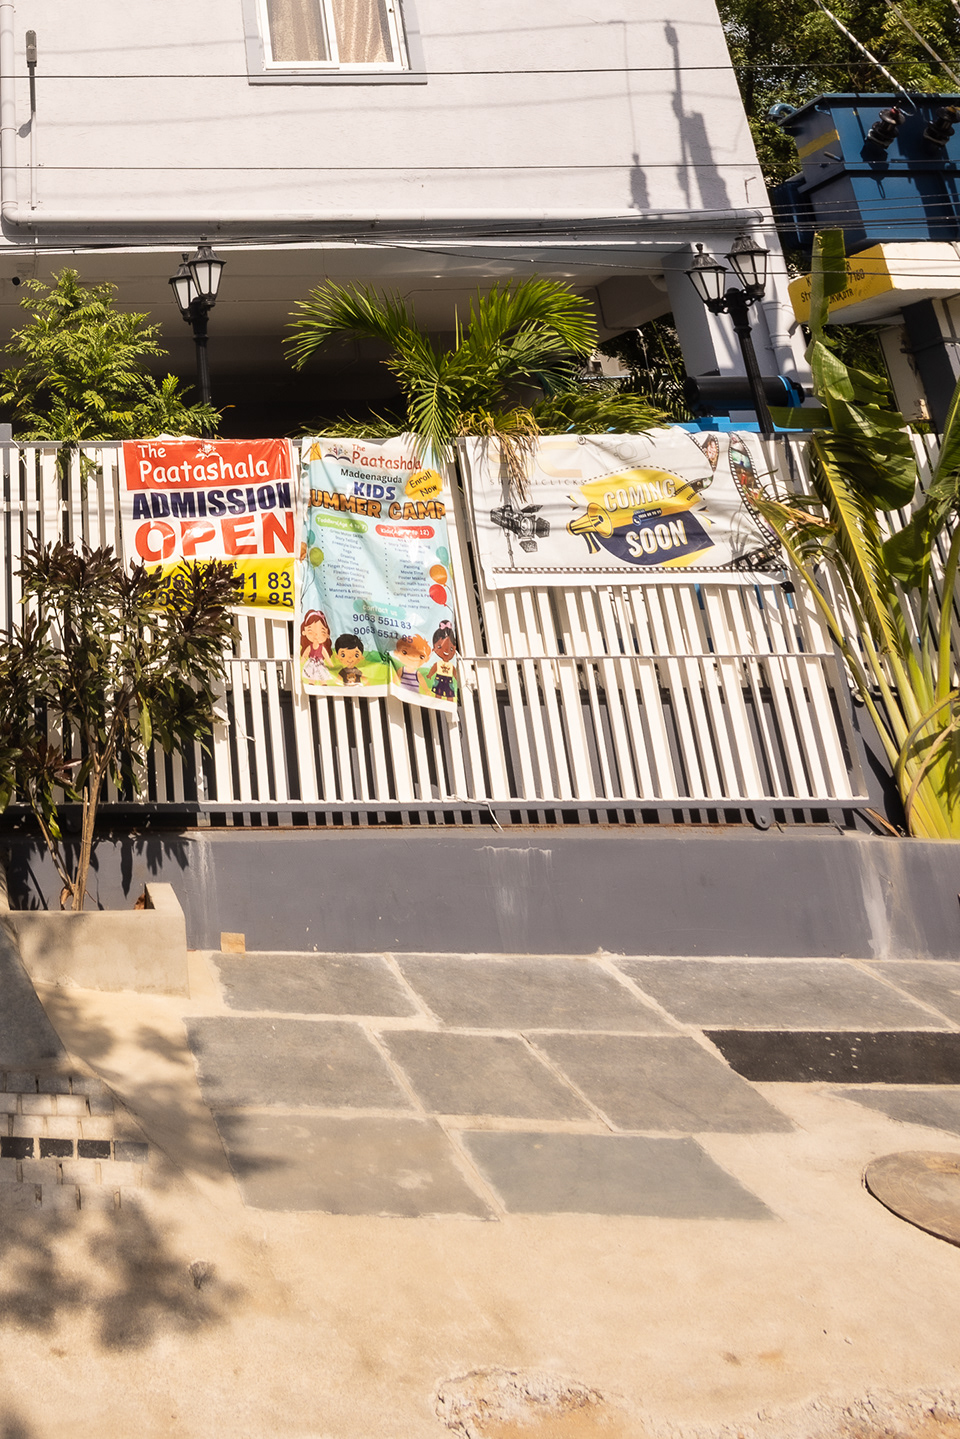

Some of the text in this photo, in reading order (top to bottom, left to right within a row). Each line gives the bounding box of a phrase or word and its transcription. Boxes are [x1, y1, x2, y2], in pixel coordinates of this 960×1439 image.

[138, 444, 166, 458] The
[351, 443, 366, 452] The
[139, 454, 270, 483] Paatashala
[351, 451, 422, 470] Paatashala
[340, 468, 403, 484] Madeenaguda
[409, 471, 432, 489] Enroll
[353, 481, 396, 500] KIDS
[419, 484, 438, 497] Now
[603, 478, 676, 512] COMING
[133, 482, 291, 520] ADMISSION
[307, 488, 447, 521] UMMER CAMP
[135, 512, 295, 562] OPEN
[625, 519, 688, 557] SOON
[267, 572, 292, 590] 83
[268, 592, 294, 607] 85
[352, 613, 412, 630] 9063 5511 83
[353, 626, 376, 635] 9063
[377, 629, 399, 640] 5511
